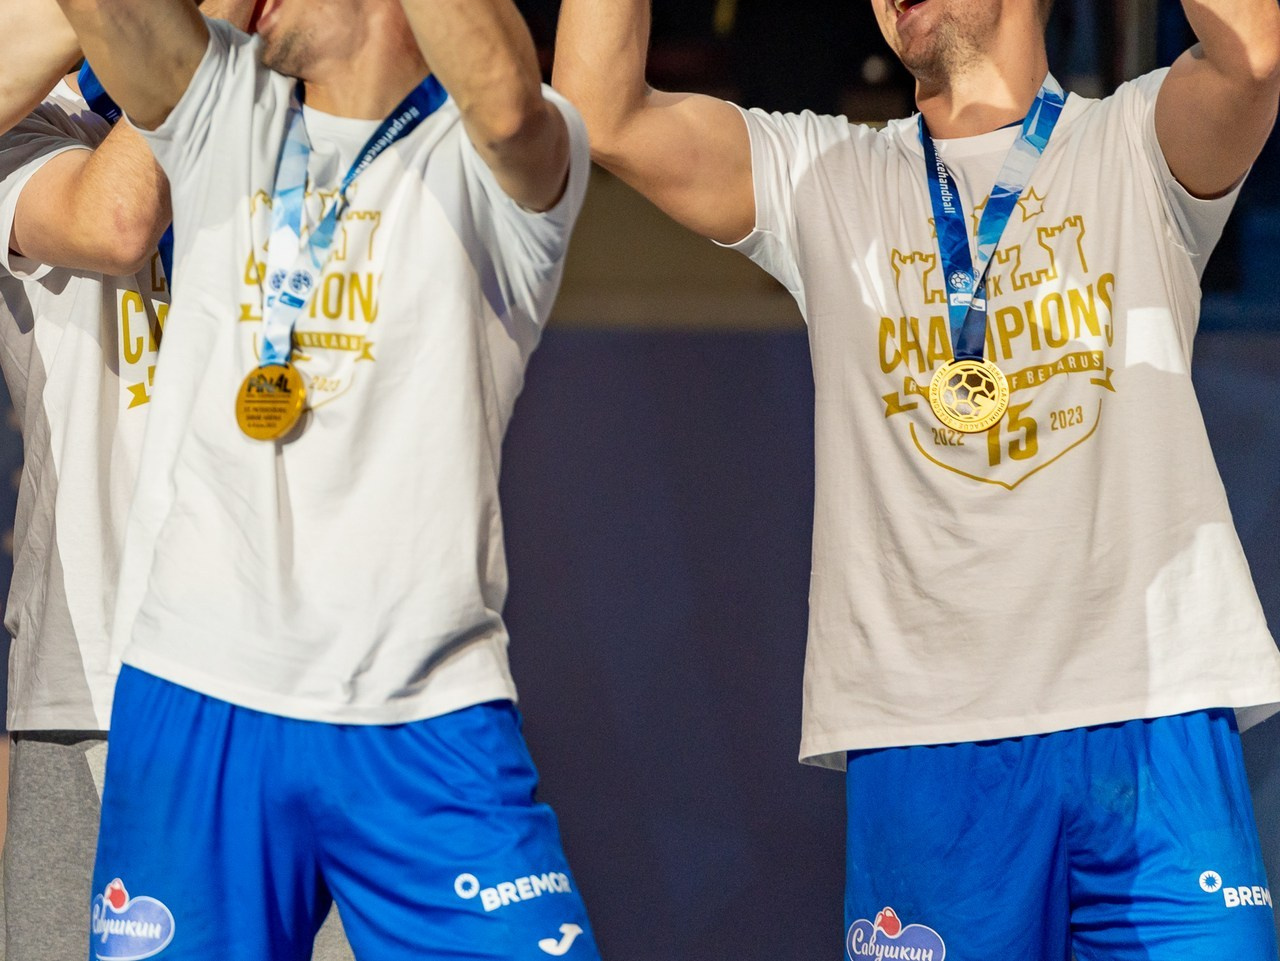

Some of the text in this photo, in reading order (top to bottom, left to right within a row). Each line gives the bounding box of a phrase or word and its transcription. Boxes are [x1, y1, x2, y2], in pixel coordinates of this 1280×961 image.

[1050, 405, 1085, 432] 2023
[480, 872, 572, 912] BREMOR
[1222, 886, 1273, 909] BREM
